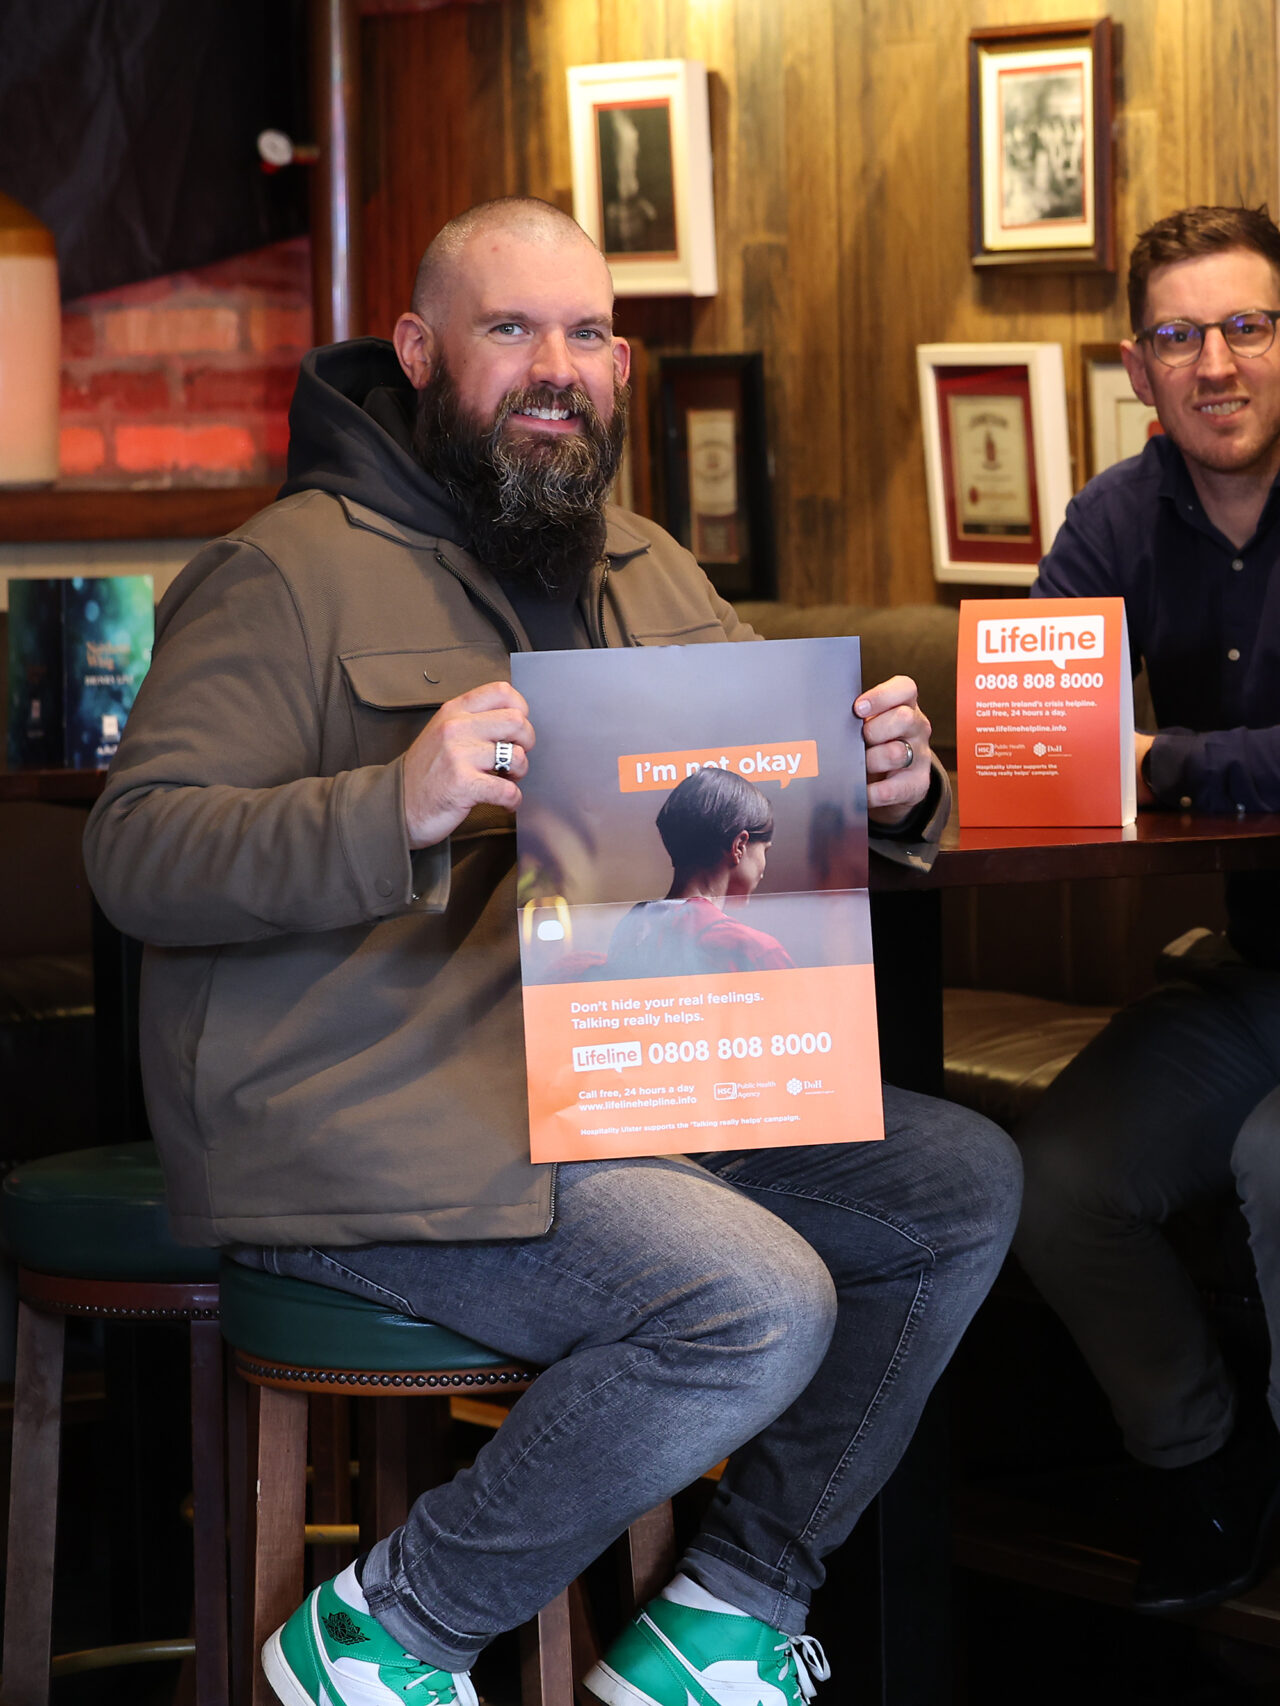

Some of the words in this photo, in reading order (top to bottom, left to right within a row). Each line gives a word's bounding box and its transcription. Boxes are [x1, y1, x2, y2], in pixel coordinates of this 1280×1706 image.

[985, 625, 1097, 654] Lifeline
[975, 673, 1018, 690] 0808
[1022, 673, 1055, 689] 808
[1060, 672, 1104, 688] 8000
[1011, 700, 1043, 708] Ireland's
[1044, 700, 1064, 708] crisis
[1065, 699, 1097, 708] helpline.
[976, 709, 991, 717] Call
[992, 709, 1010, 718] free,
[1011, 709, 1021, 717] 24
[1022, 709, 1043, 717] hours
[1051, 709, 1067, 718] day.
[976, 724, 1067, 733] www.lifelinehelpline.info
[636, 761, 677, 783] I'm
[738, 751, 802, 775] okay
[570, 1000, 608, 1013] Don't
[611, 999, 641, 1011] hide
[644, 998, 675, 1011] your
[678, 994, 704, 1006] real
[707, 991, 765, 1005] feelings.
[571, 1016, 620, 1030] Talking
[623, 1013, 660, 1026] really
[664, 1011, 704, 1025] helps.
[576, 1046, 638, 1067] Lifeline
[648, 1039, 710, 1064] 0808
[717, 1036, 763, 1060] 808
[770, 1031, 832, 1056] 8000
[578, 1090, 598, 1099] Call
[599, 1089, 622, 1098] free,
[624, 1087, 637, 1096] 24
[639, 1087, 666, 1095] hours
[677, 1084, 695, 1093] day
[717, 1087, 732, 1095] HSC
[737, 1091, 760, 1099] Agency
[578, 1096, 697, 1111] www.lifelinehelpline.info
[580, 1127, 620, 1136] Hospitality
[643, 1123, 676, 1132] supports
[719, 1118, 740, 1126] really
[764, 1114, 801, 1123] campaign.
